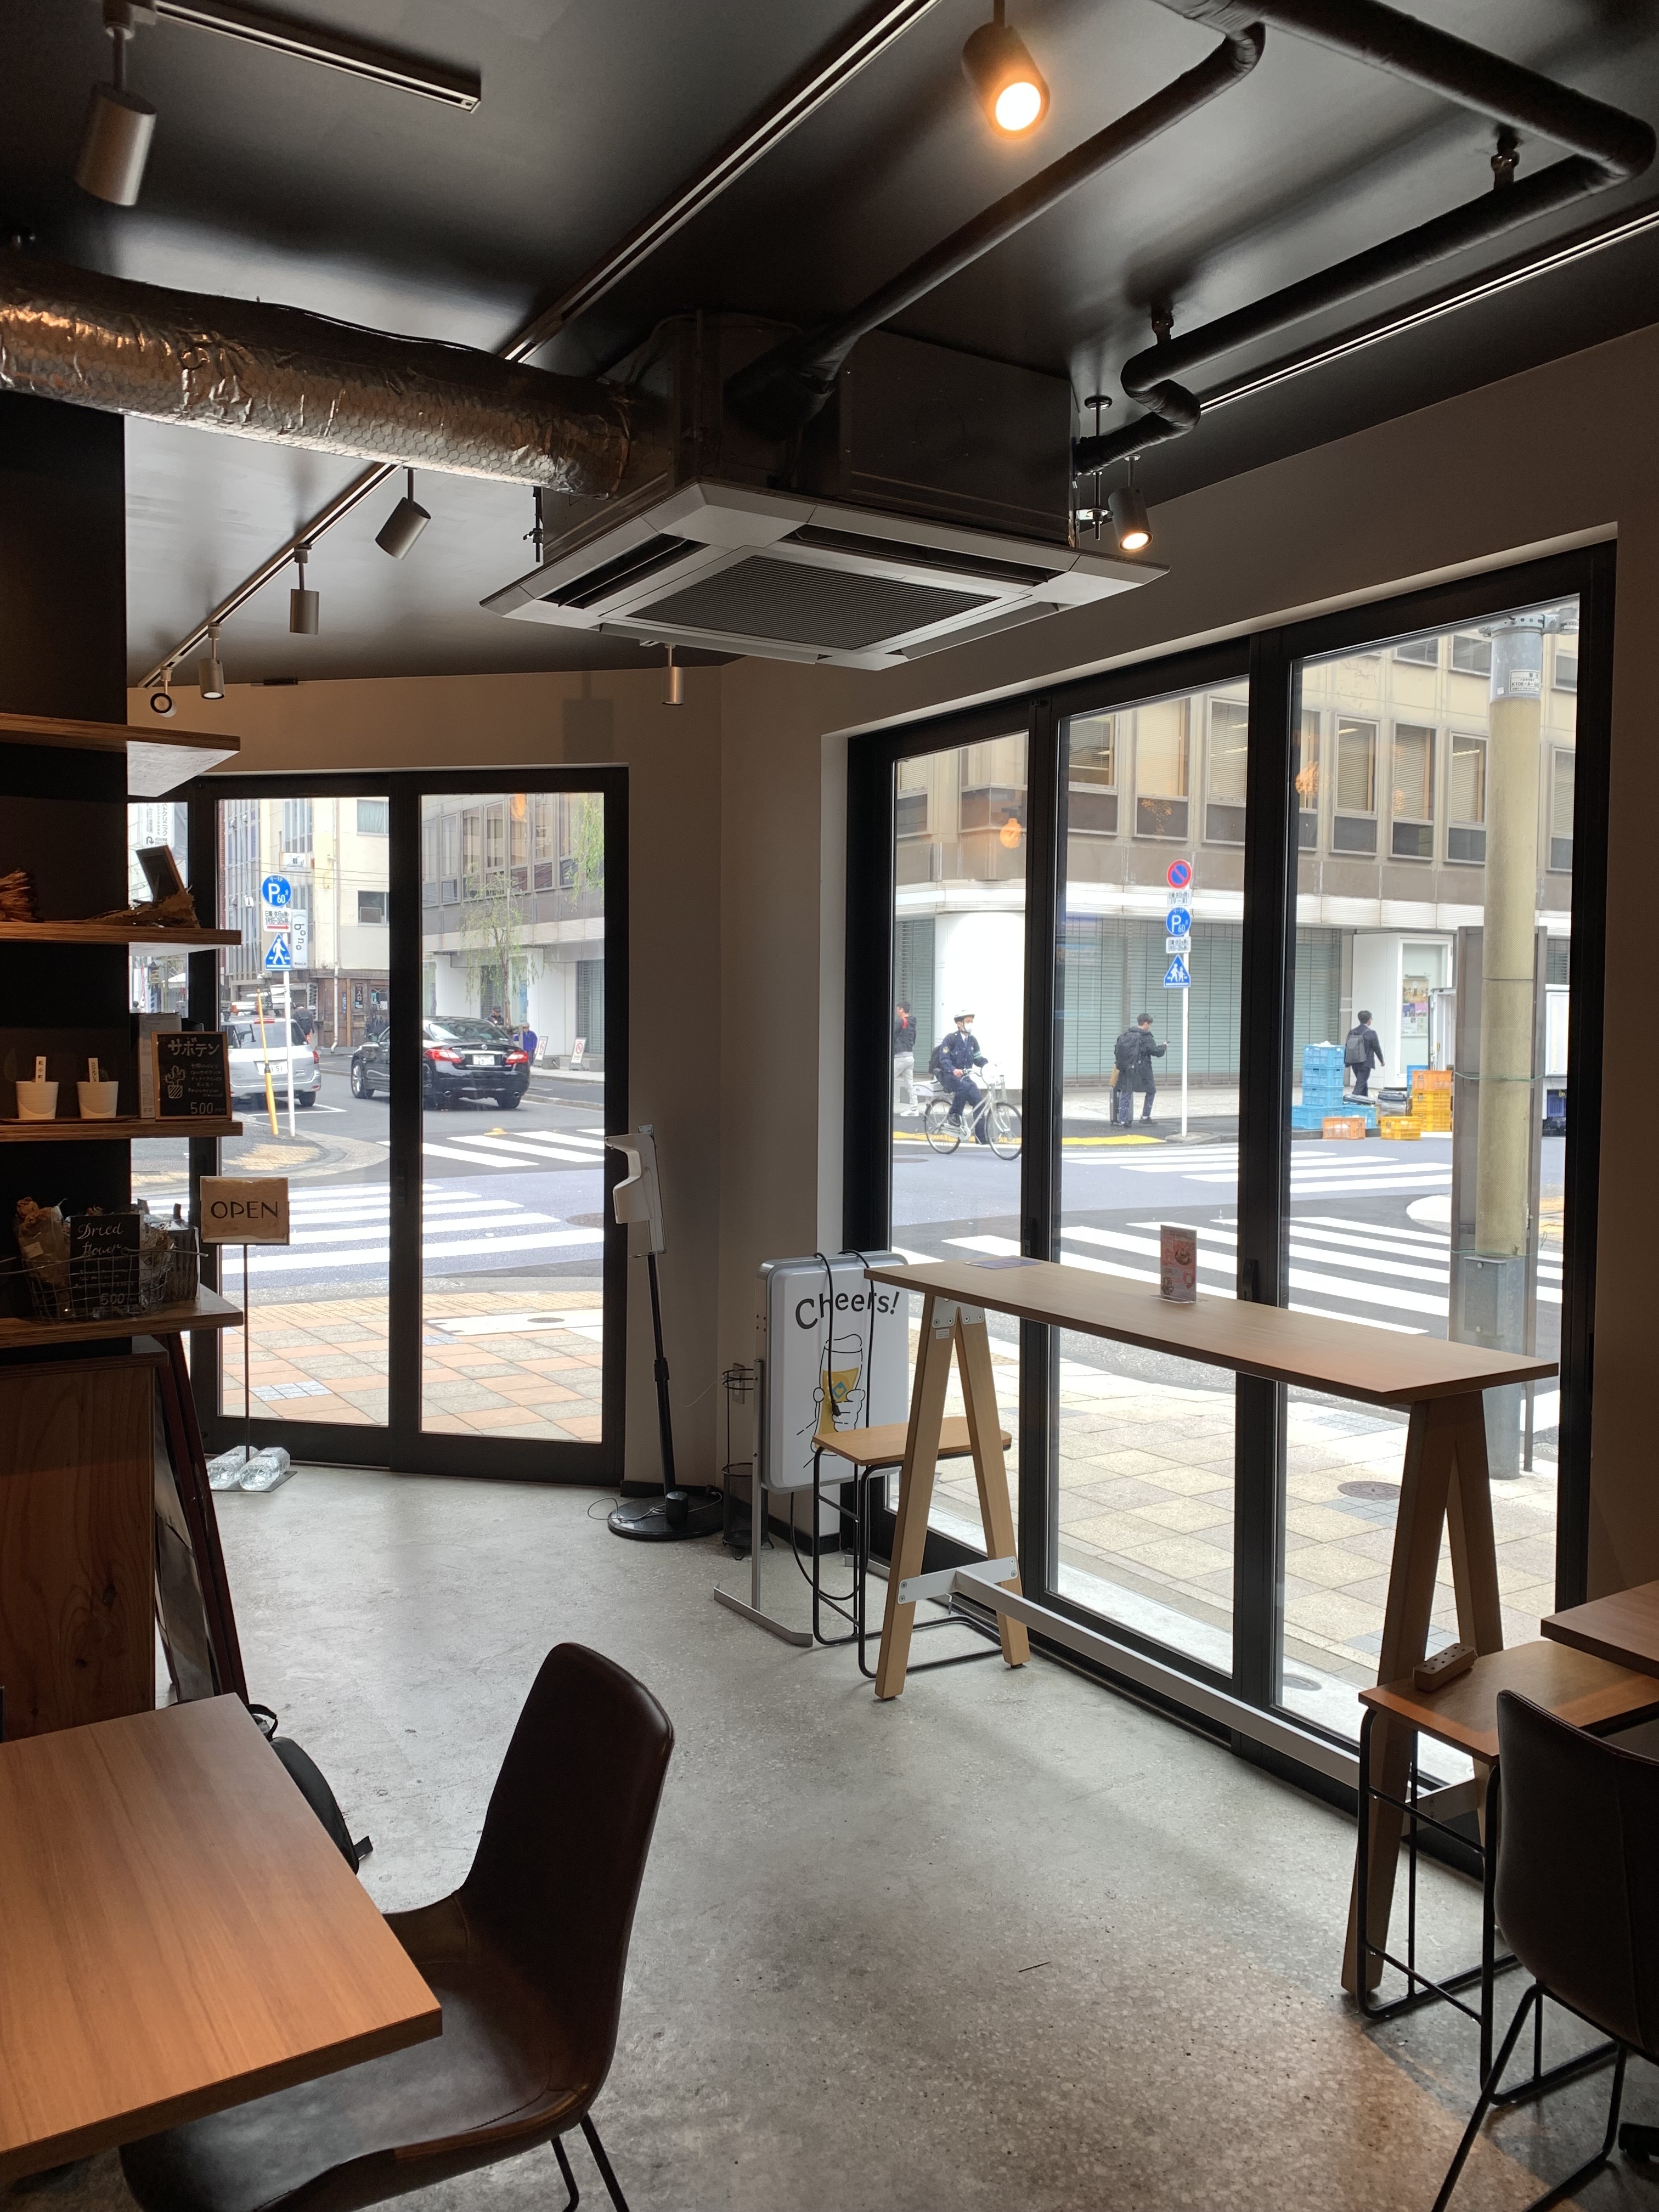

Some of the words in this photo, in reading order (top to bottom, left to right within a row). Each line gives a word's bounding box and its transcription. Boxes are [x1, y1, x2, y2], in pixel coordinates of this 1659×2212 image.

[268, 883, 280, 904] P
[276, 894, 286, 904] 60
[1171, 915, 1181, 933] P
[1178, 924, 1186, 933] 60
[167, 1037, 220, 1057] サボテン
[190, 1102, 213, 1114] 500
[211, 1201, 279, 1218] OPEN
[77, 1222, 123, 1240] Dried
[82, 1241, 122, 1257] flower
[100, 1293, 125, 1305] 500
[795, 1291, 900, 1329] Cheers!
